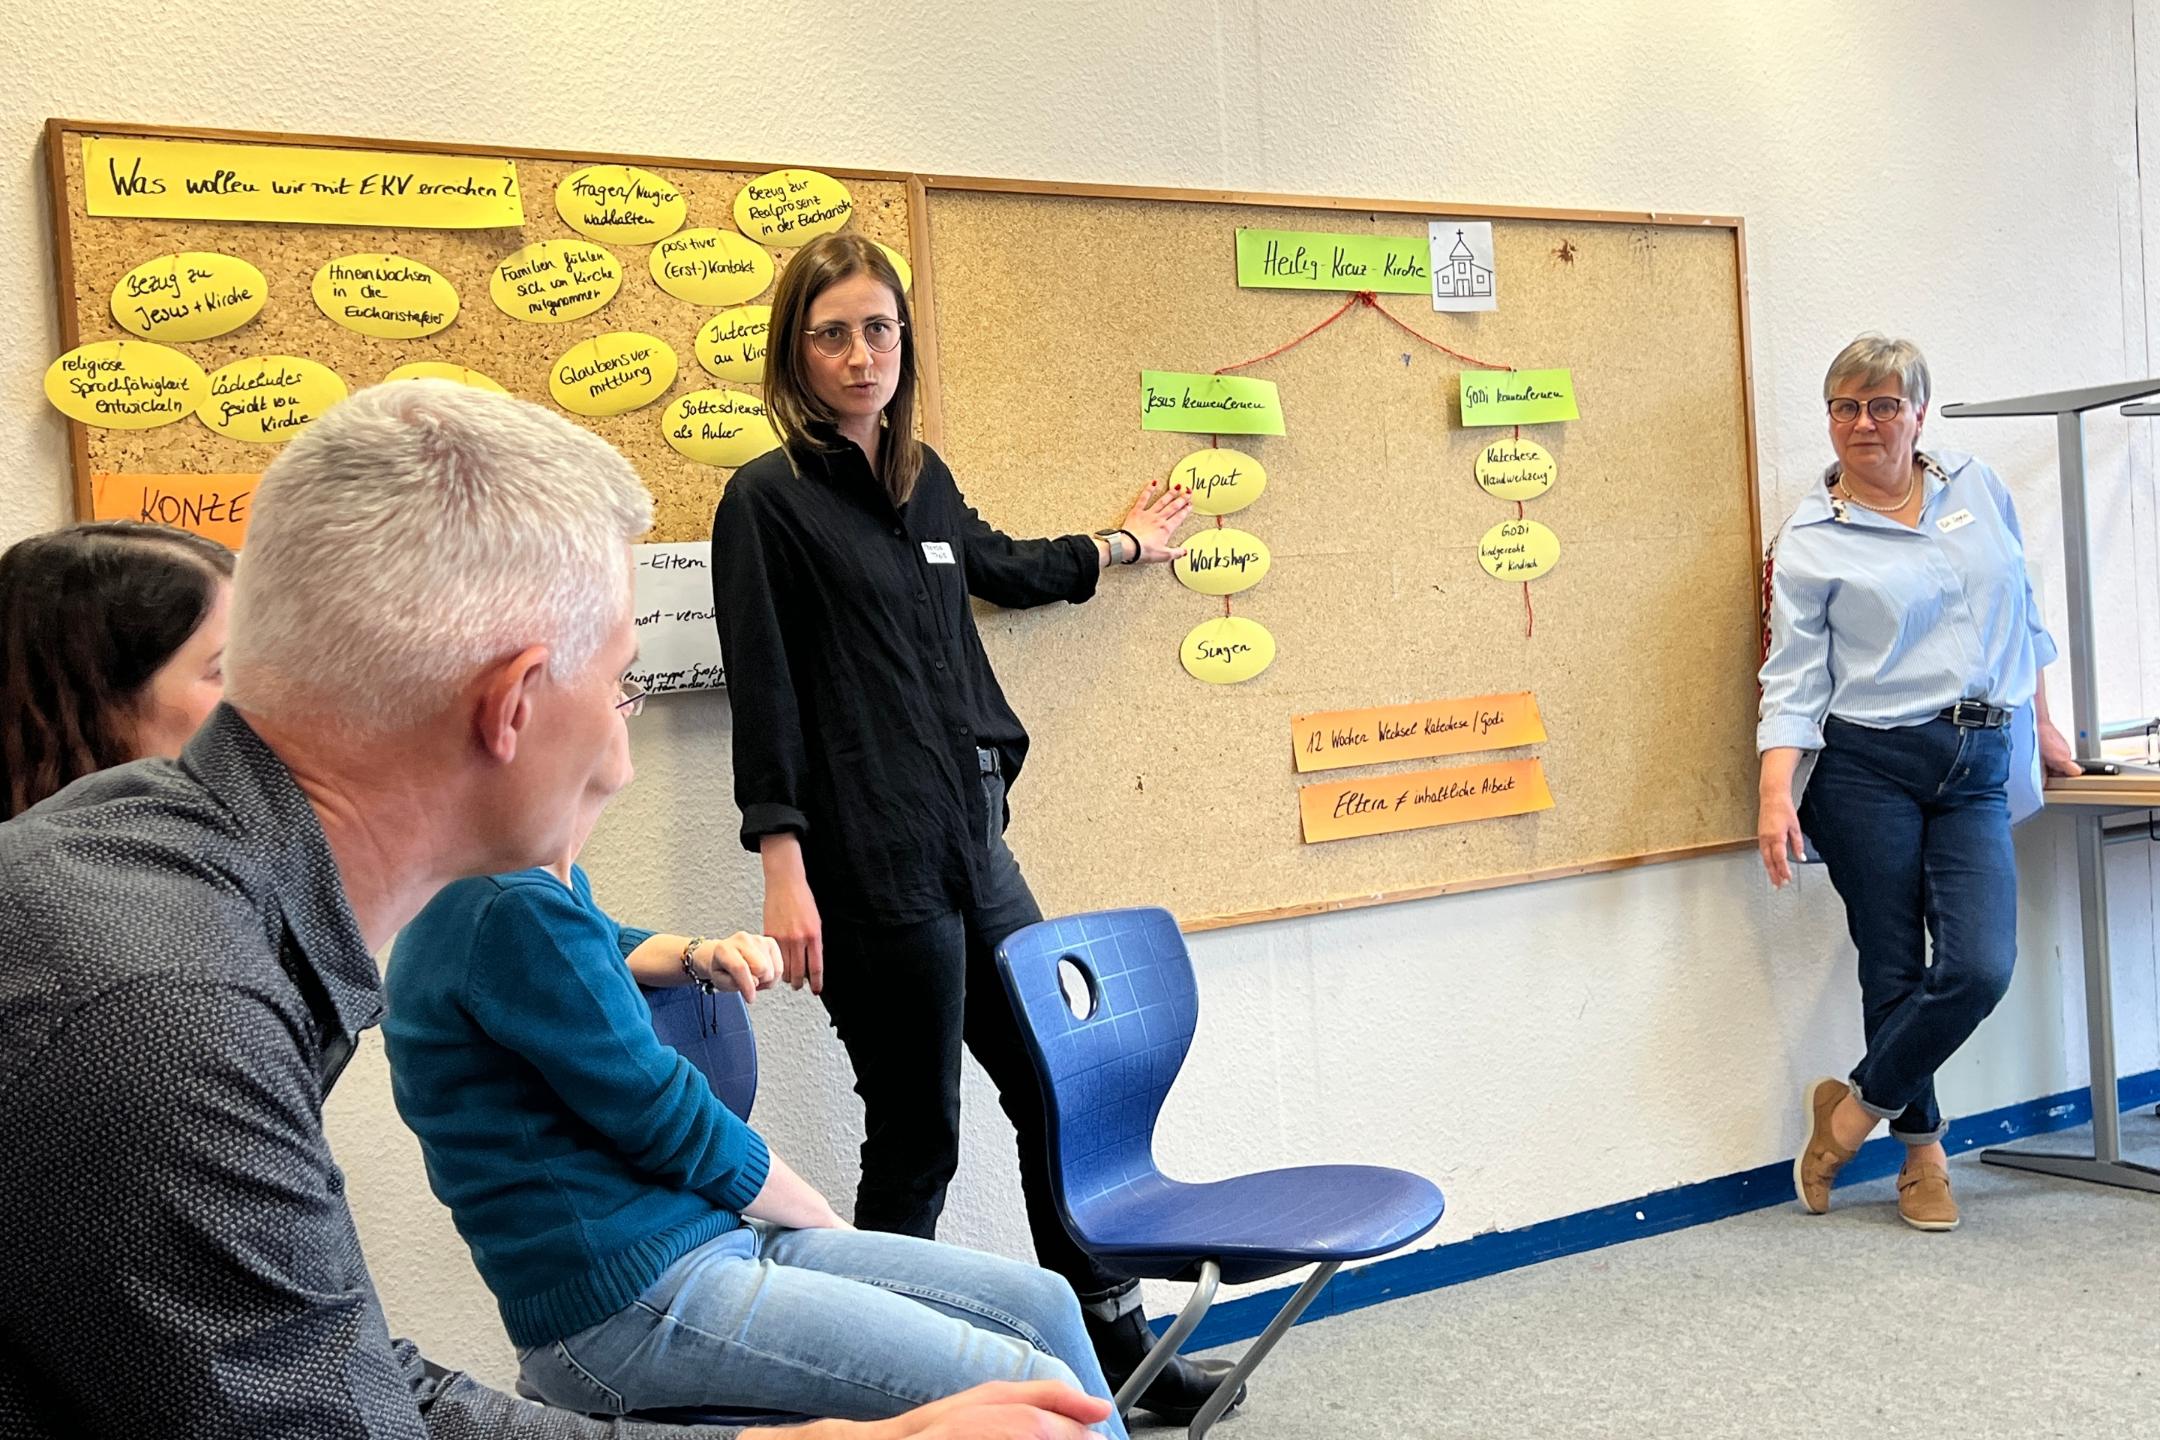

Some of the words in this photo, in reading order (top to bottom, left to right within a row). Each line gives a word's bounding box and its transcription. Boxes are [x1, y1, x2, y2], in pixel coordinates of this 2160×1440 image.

[109, 157, 167, 196] Was
[186, 170, 260, 194] wollen
[272, 179, 306, 194] wir
[311, 177, 354, 195] mit
[360, 174, 414, 196] EKV
[749, 186, 786, 202] Bezug
[789, 180, 808, 193] zur
[584, 209, 655, 226] wachhalten
[749, 196, 822, 220] Realpräsenz
[762, 222, 773, 235] in
[777, 218, 795, 232] der
[662, 238, 717, 259] positiver
[501, 260, 557, 282] Familien
[563, 251, 605, 273] fühlen
[1384, 252, 1427, 278] Kirche
[127, 274, 181, 298] Bezug
[187, 269, 214, 283] zu
[333, 282, 347, 297] in
[361, 285, 388, 298] die
[517, 281, 546, 297] sich
[550, 279, 568, 289] von
[573, 267, 614, 285] Kirche
[135, 305, 189, 331] Jesus
[194, 301, 202, 312] +
[204, 286, 253, 312] Kirche
[62, 355, 125, 379] religiöse
[70, 376, 190, 399] Sprachfähigkeit
[212, 368, 302, 396] Lächelndes
[589, 366, 652, 398] mittlung
[274, 397, 300, 408] von
[1144, 387, 1176, 413] Jesus
[1182, 387, 1265, 410] kennenlernen
[261, 409, 318, 433] Kirche
[673, 424, 693, 438] als
[702, 422, 743, 440] Anker
[1487, 448, 1540, 463] Katechese
[1186, 467, 1242, 498] Input
[1190, 547, 1259, 573] Workshops
[1195, 640, 1252, 663] Singen
[1306, 730, 1323, 754] 12
[1332, 727, 1369, 749] Wochen
[1379, 721, 1418, 742] Wechsel
[1333, 790, 1388, 819] Eltern
[1414, 780, 1476, 804] inhaltliche
[1481, 776, 1515, 794] Arbeit
